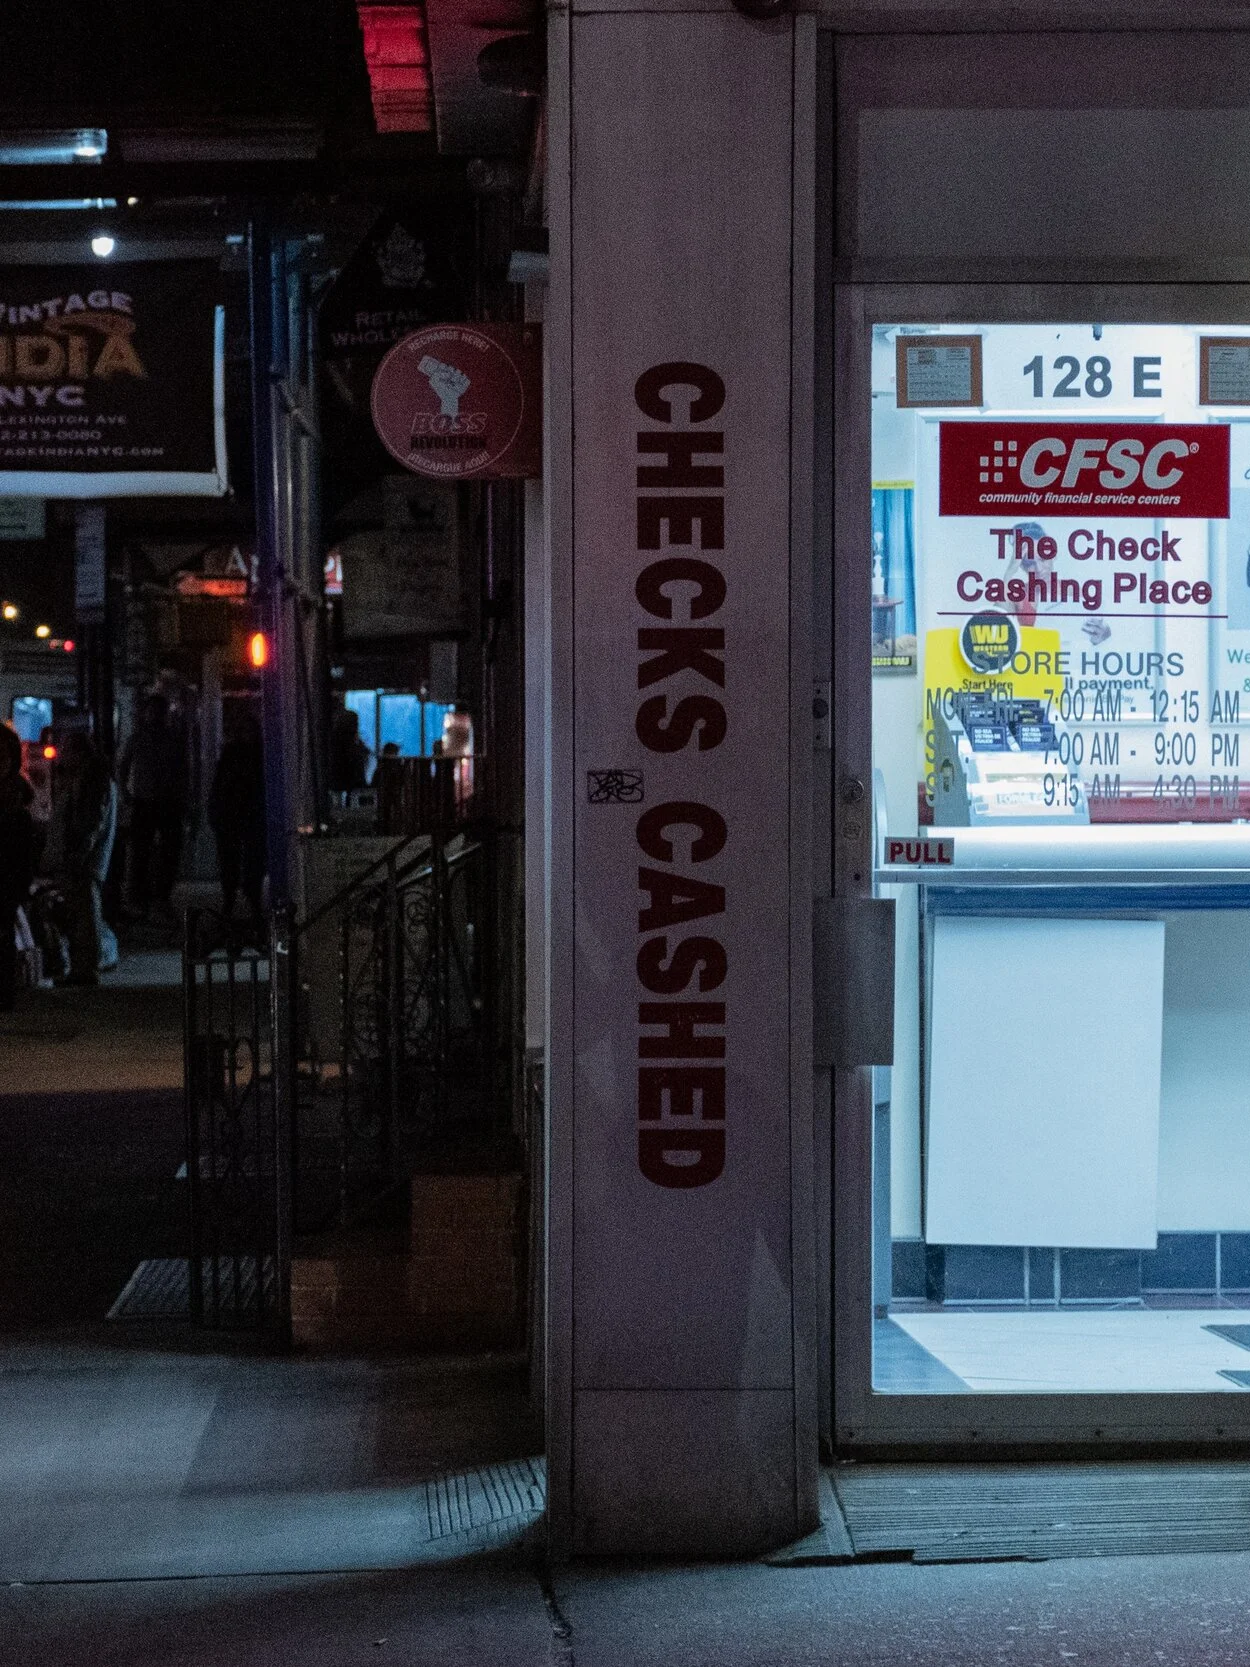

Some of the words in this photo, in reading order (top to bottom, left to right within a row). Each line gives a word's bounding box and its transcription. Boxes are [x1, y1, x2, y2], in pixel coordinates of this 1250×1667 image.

[1023, 354, 1114, 399] 128
[1133, 356, 1163, 399] E
[410, 412, 489, 434] BOSS
[978, 493, 1042, 506] community
[1044, 492, 1093, 505] financial
[1094, 494, 1137, 505] service
[1138, 493, 1182, 506] centers
[633, 361, 728, 754] CHECKS
[989, 528, 1058, 561] The
[1068, 530, 1182, 562] Check
[1113, 572, 1213, 605] Place
[1081, 653, 1184, 677] HOURS
[962, 679, 987, 690] Start
[1079, 677, 1154, 693] payment.
[1043, 689, 1084, 722] 7:00
[1091, 689, 1121, 722] AM
[1149, 690, 1200, 724] 12:15
[1210, 690, 1240, 724] AM
[1089, 731, 1120, 766] AM
[1154, 732, 1197, 766] 9:00
[1211, 732, 1240, 767] PM
[1043, 773, 1080, 807] 9:15
[1091, 773, 1121, 807] AM
[1210, 774, 1240, 811] PM
[889, 841, 951, 864] PULL
[634, 801, 728, 1189] CASHED
